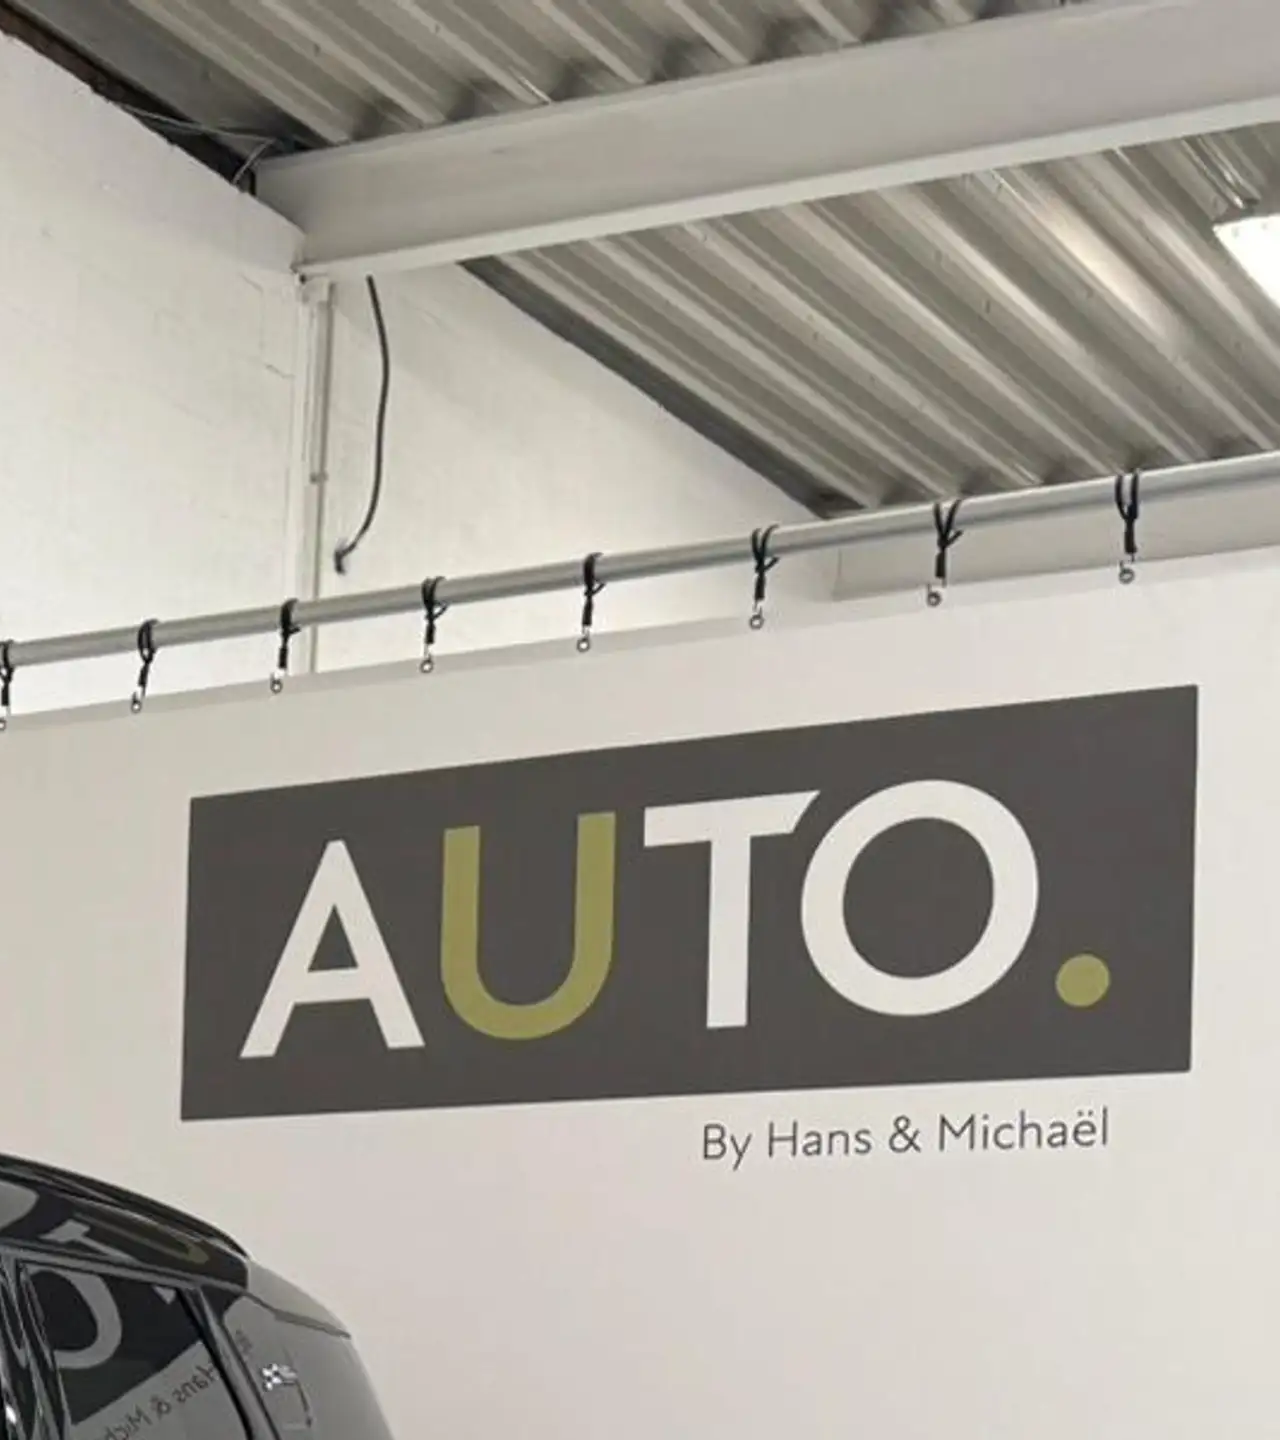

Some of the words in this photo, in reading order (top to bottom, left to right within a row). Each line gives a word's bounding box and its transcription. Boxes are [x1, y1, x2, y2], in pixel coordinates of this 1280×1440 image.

[239, 778, 1110, 1059] AUTO.
[702, 1123, 752, 1172] By
[768, 1120, 872, 1158] Hans
[888, 1114, 921, 1154] &
[938, 1106, 1108, 1152] Michaël
